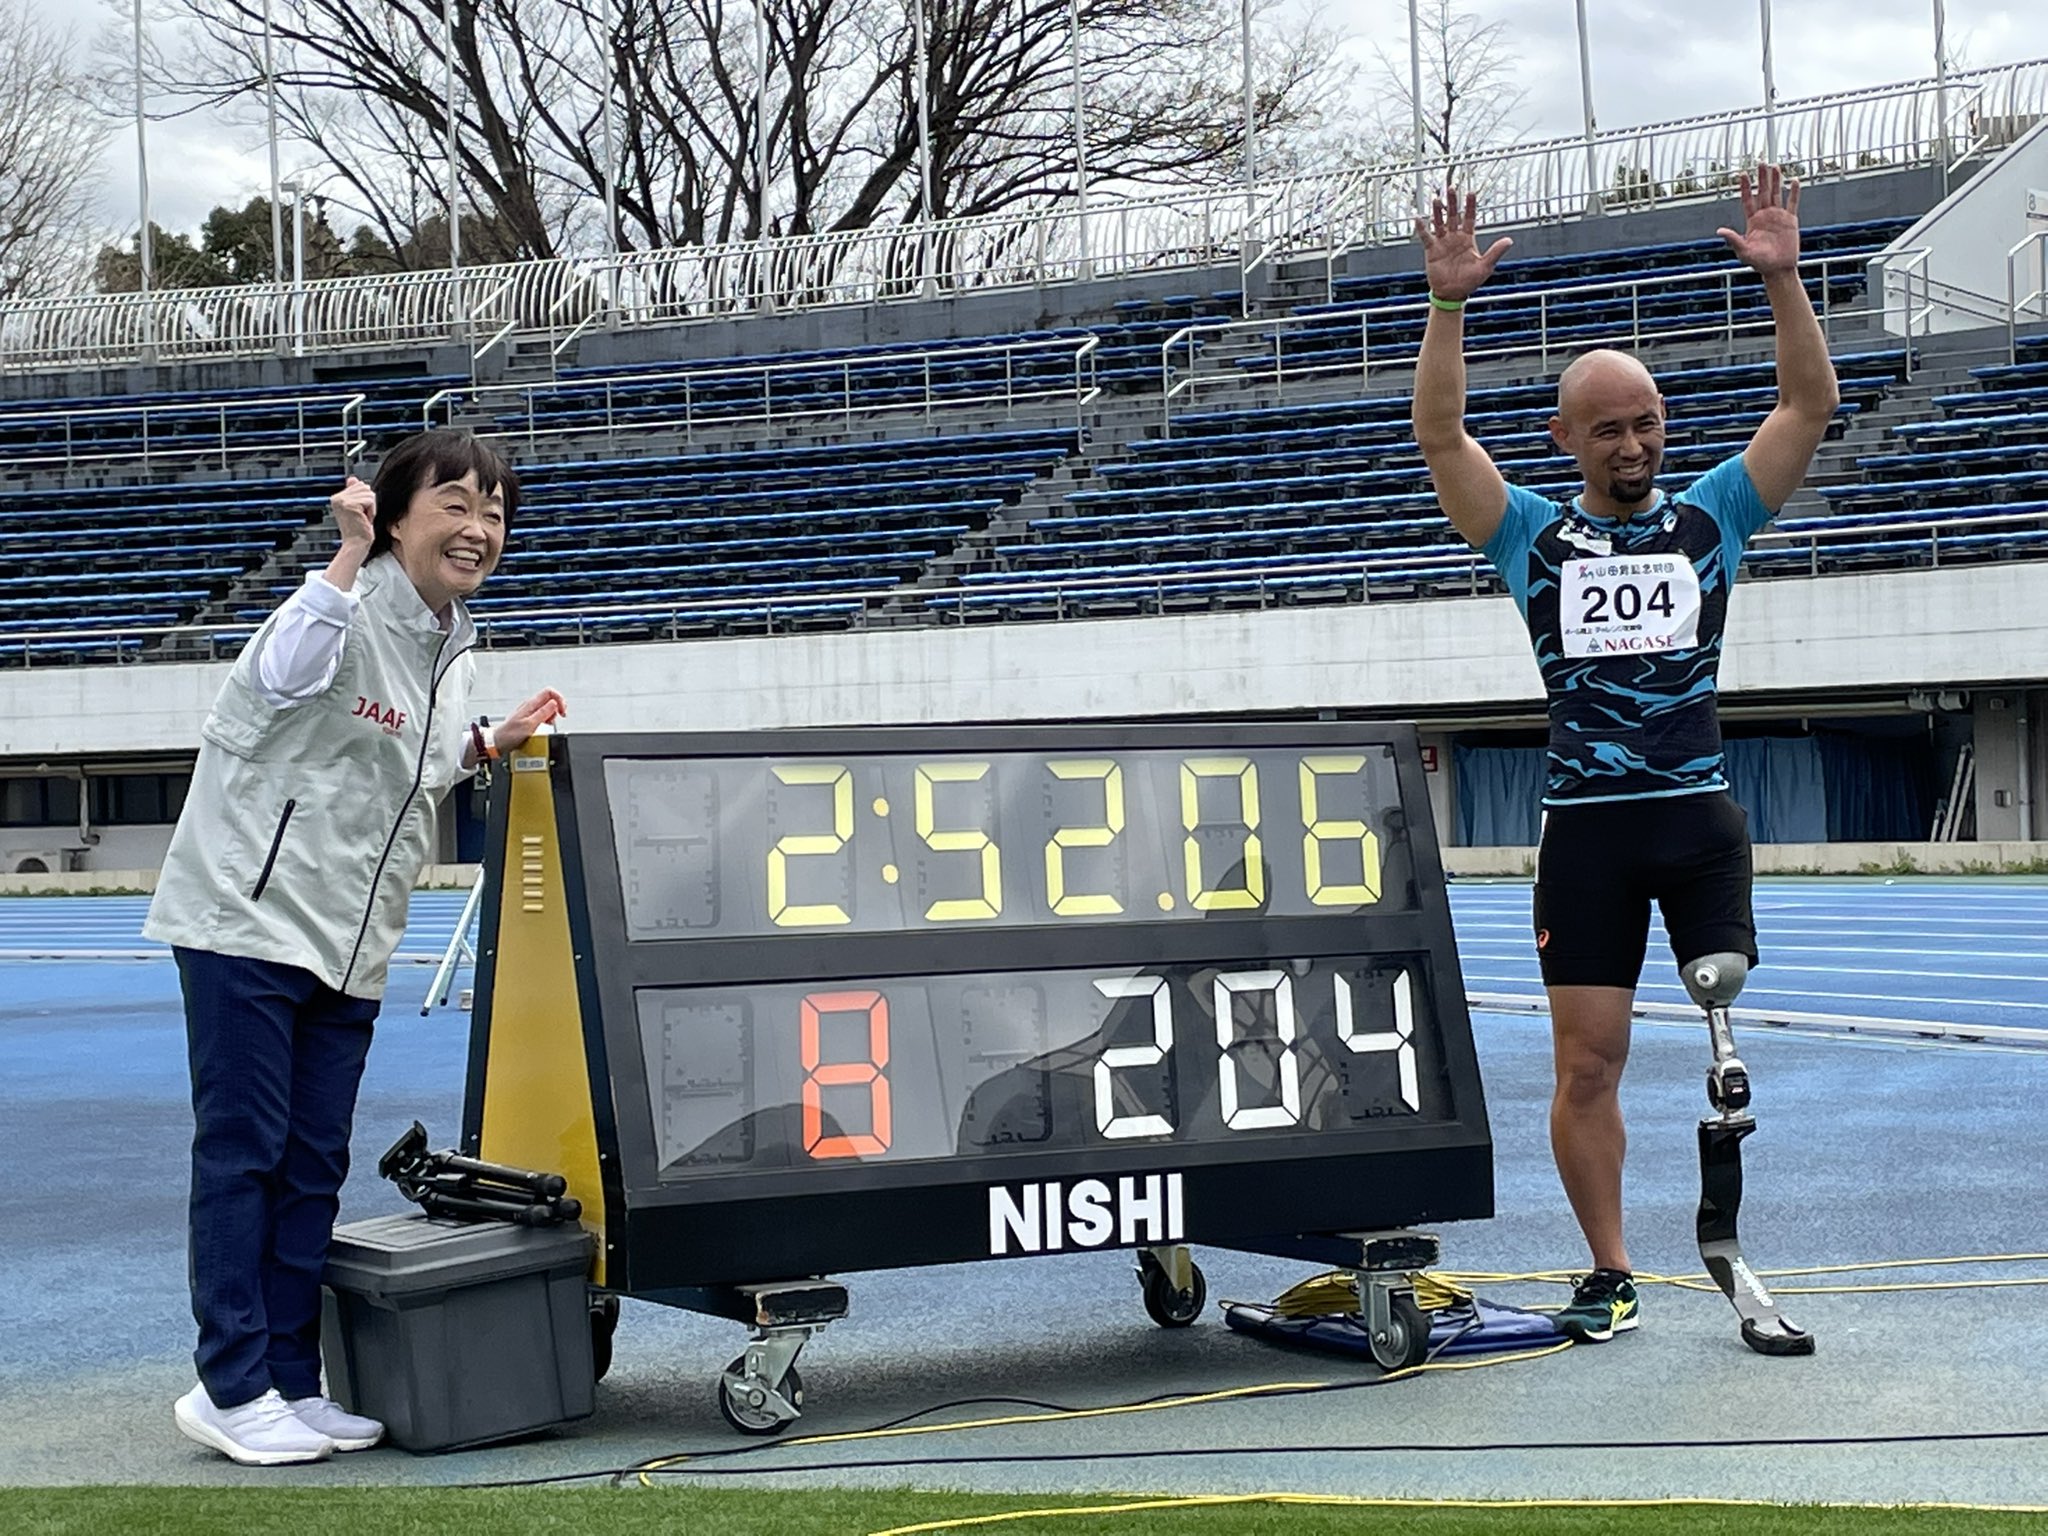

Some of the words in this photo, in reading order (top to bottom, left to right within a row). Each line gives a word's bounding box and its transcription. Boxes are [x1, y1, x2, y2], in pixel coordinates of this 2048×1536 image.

[1581, 580, 1675, 624] 204
[1604, 635, 1676, 653] NAGASE
[351, 696, 407, 730] JAAF
[767, 756, 1383, 927] 2:52.06
[801, 991, 892, 1160] 8
[1093, 970, 1421, 1140] 204
[989, 1173, 1184, 1255] NISHI
